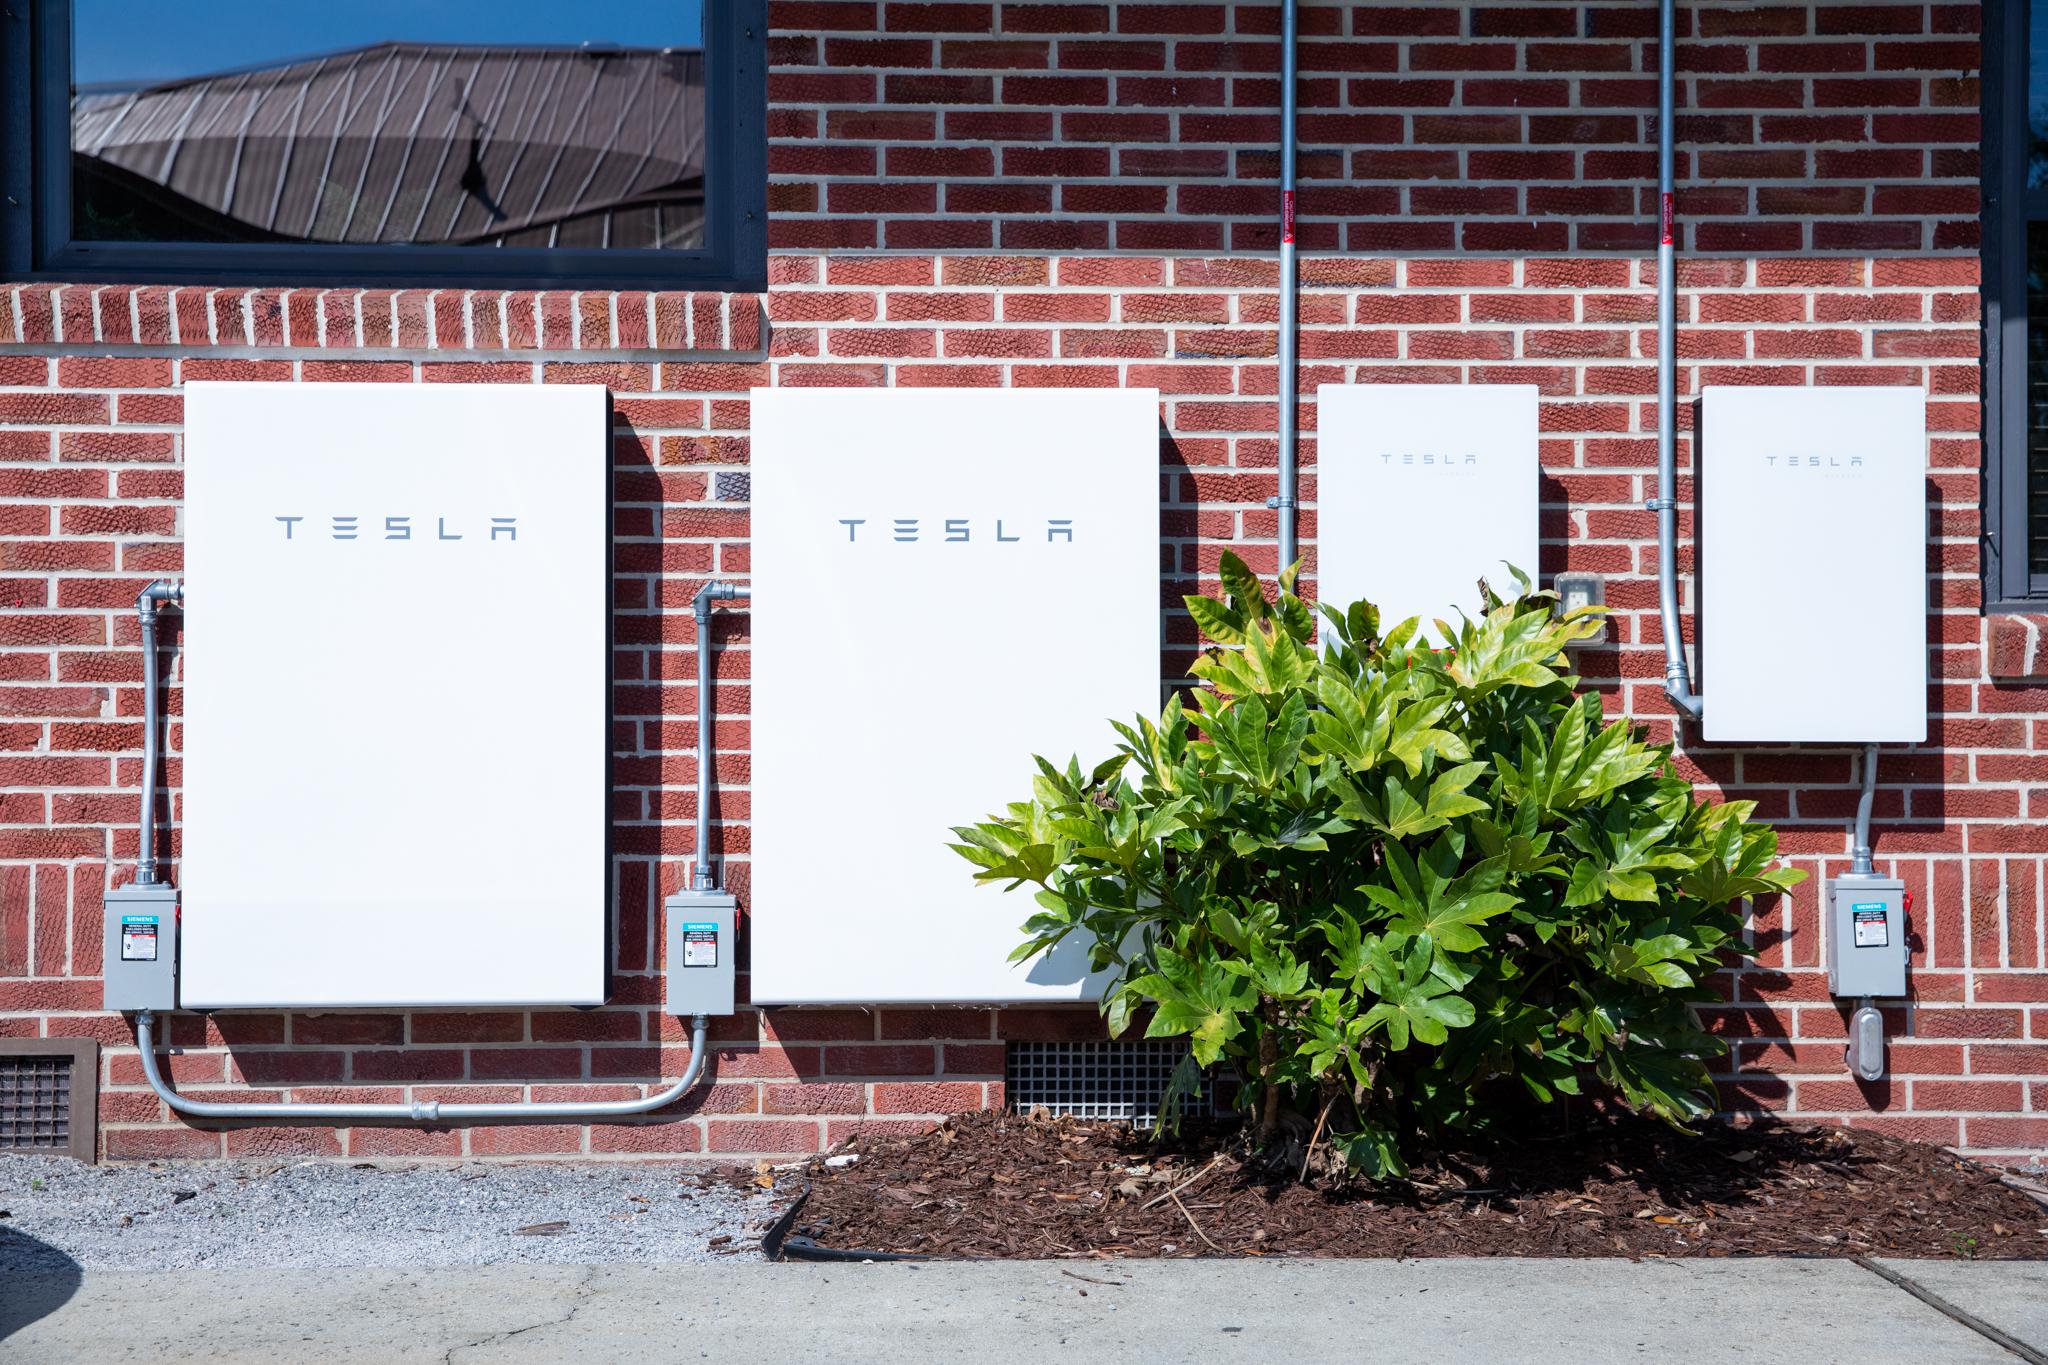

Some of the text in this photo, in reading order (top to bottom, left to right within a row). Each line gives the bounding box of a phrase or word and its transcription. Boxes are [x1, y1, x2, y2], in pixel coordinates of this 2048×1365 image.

[1380, 453, 1477, 465] TESLA
[1765, 455, 1863, 467] TESLA
[275, 516, 517, 541] TESLA
[839, 519, 1073, 543] TESLA
